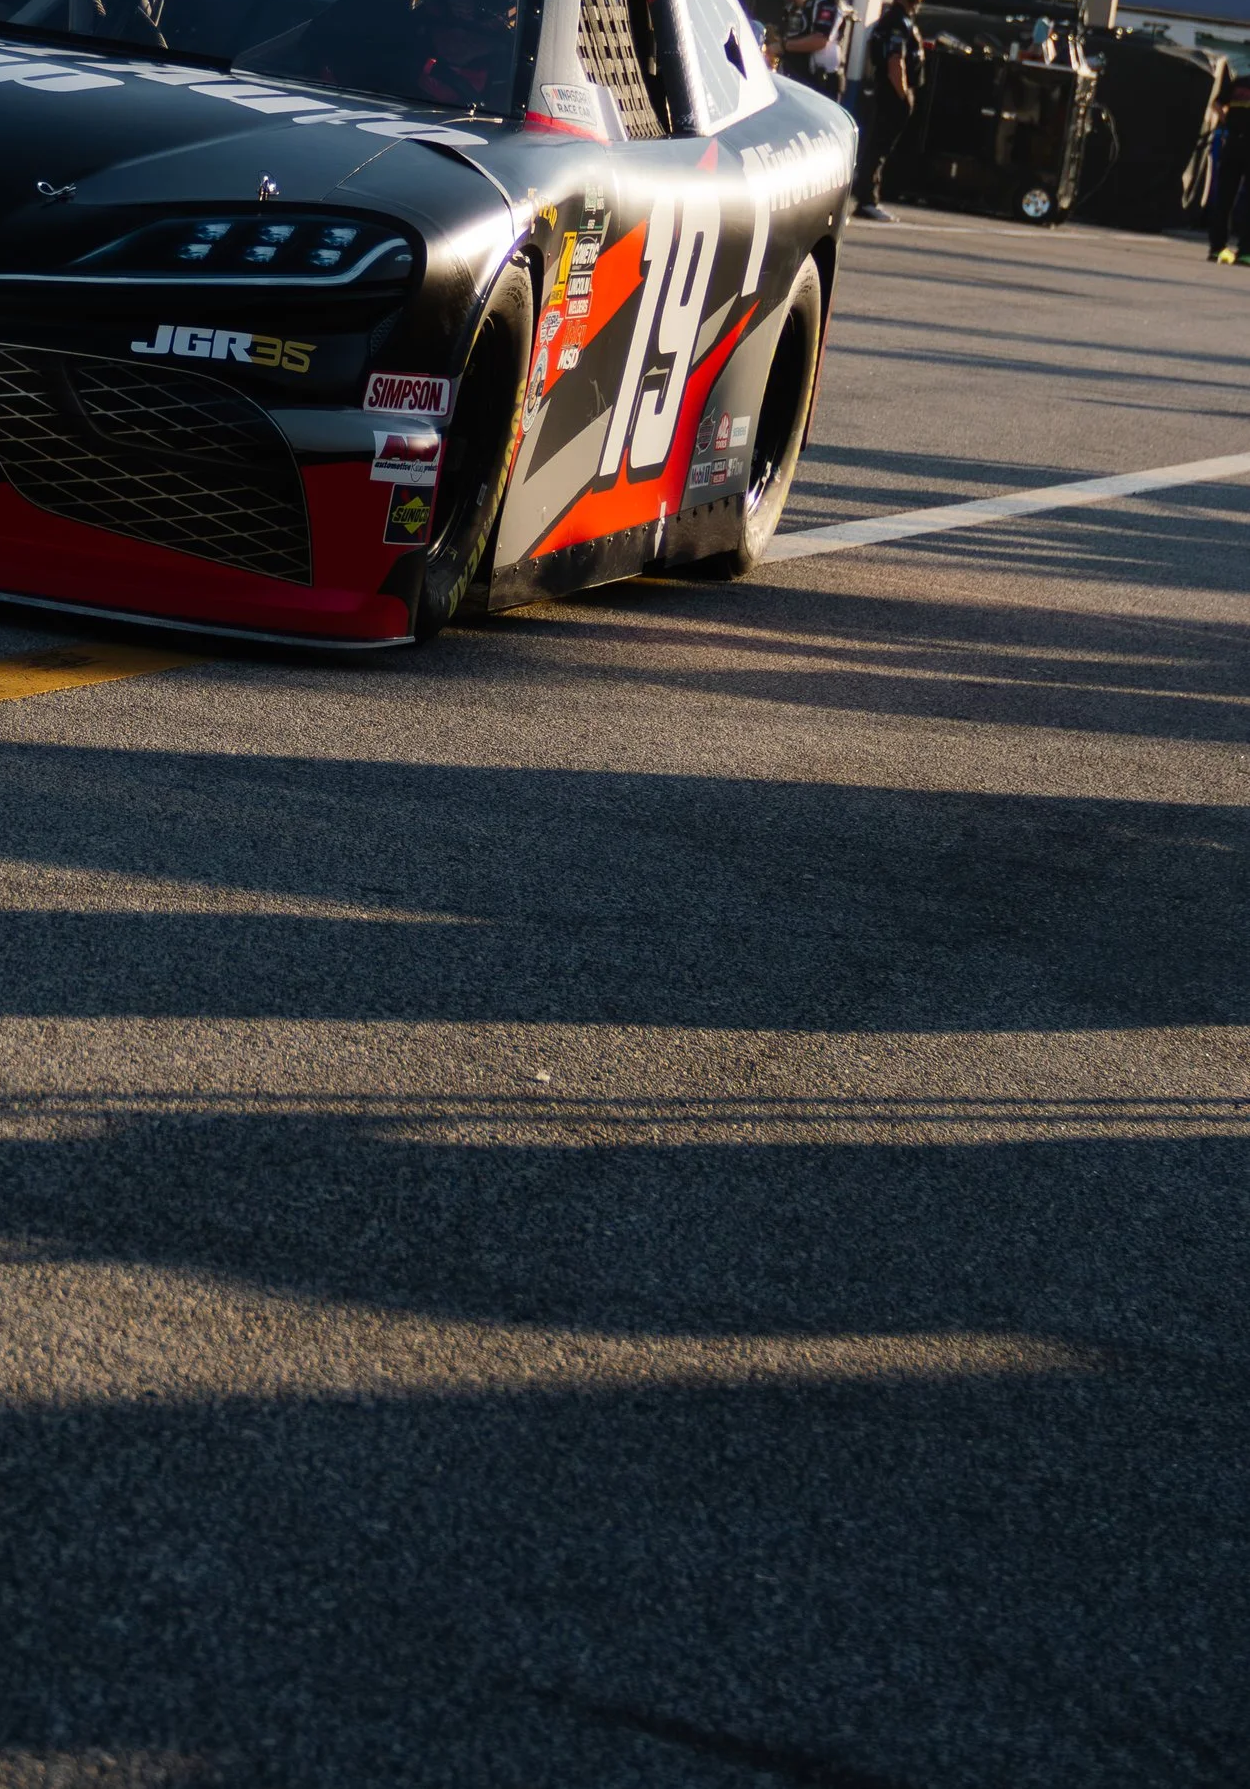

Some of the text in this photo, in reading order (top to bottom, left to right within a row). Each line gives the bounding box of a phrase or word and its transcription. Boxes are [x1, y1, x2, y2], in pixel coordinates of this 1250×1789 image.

[600, 178, 722, 477] 19
[556, 348, 580, 371] MSD
[368, 376, 444, 412] SIMPSON
[374, 461, 411, 472] automotive
